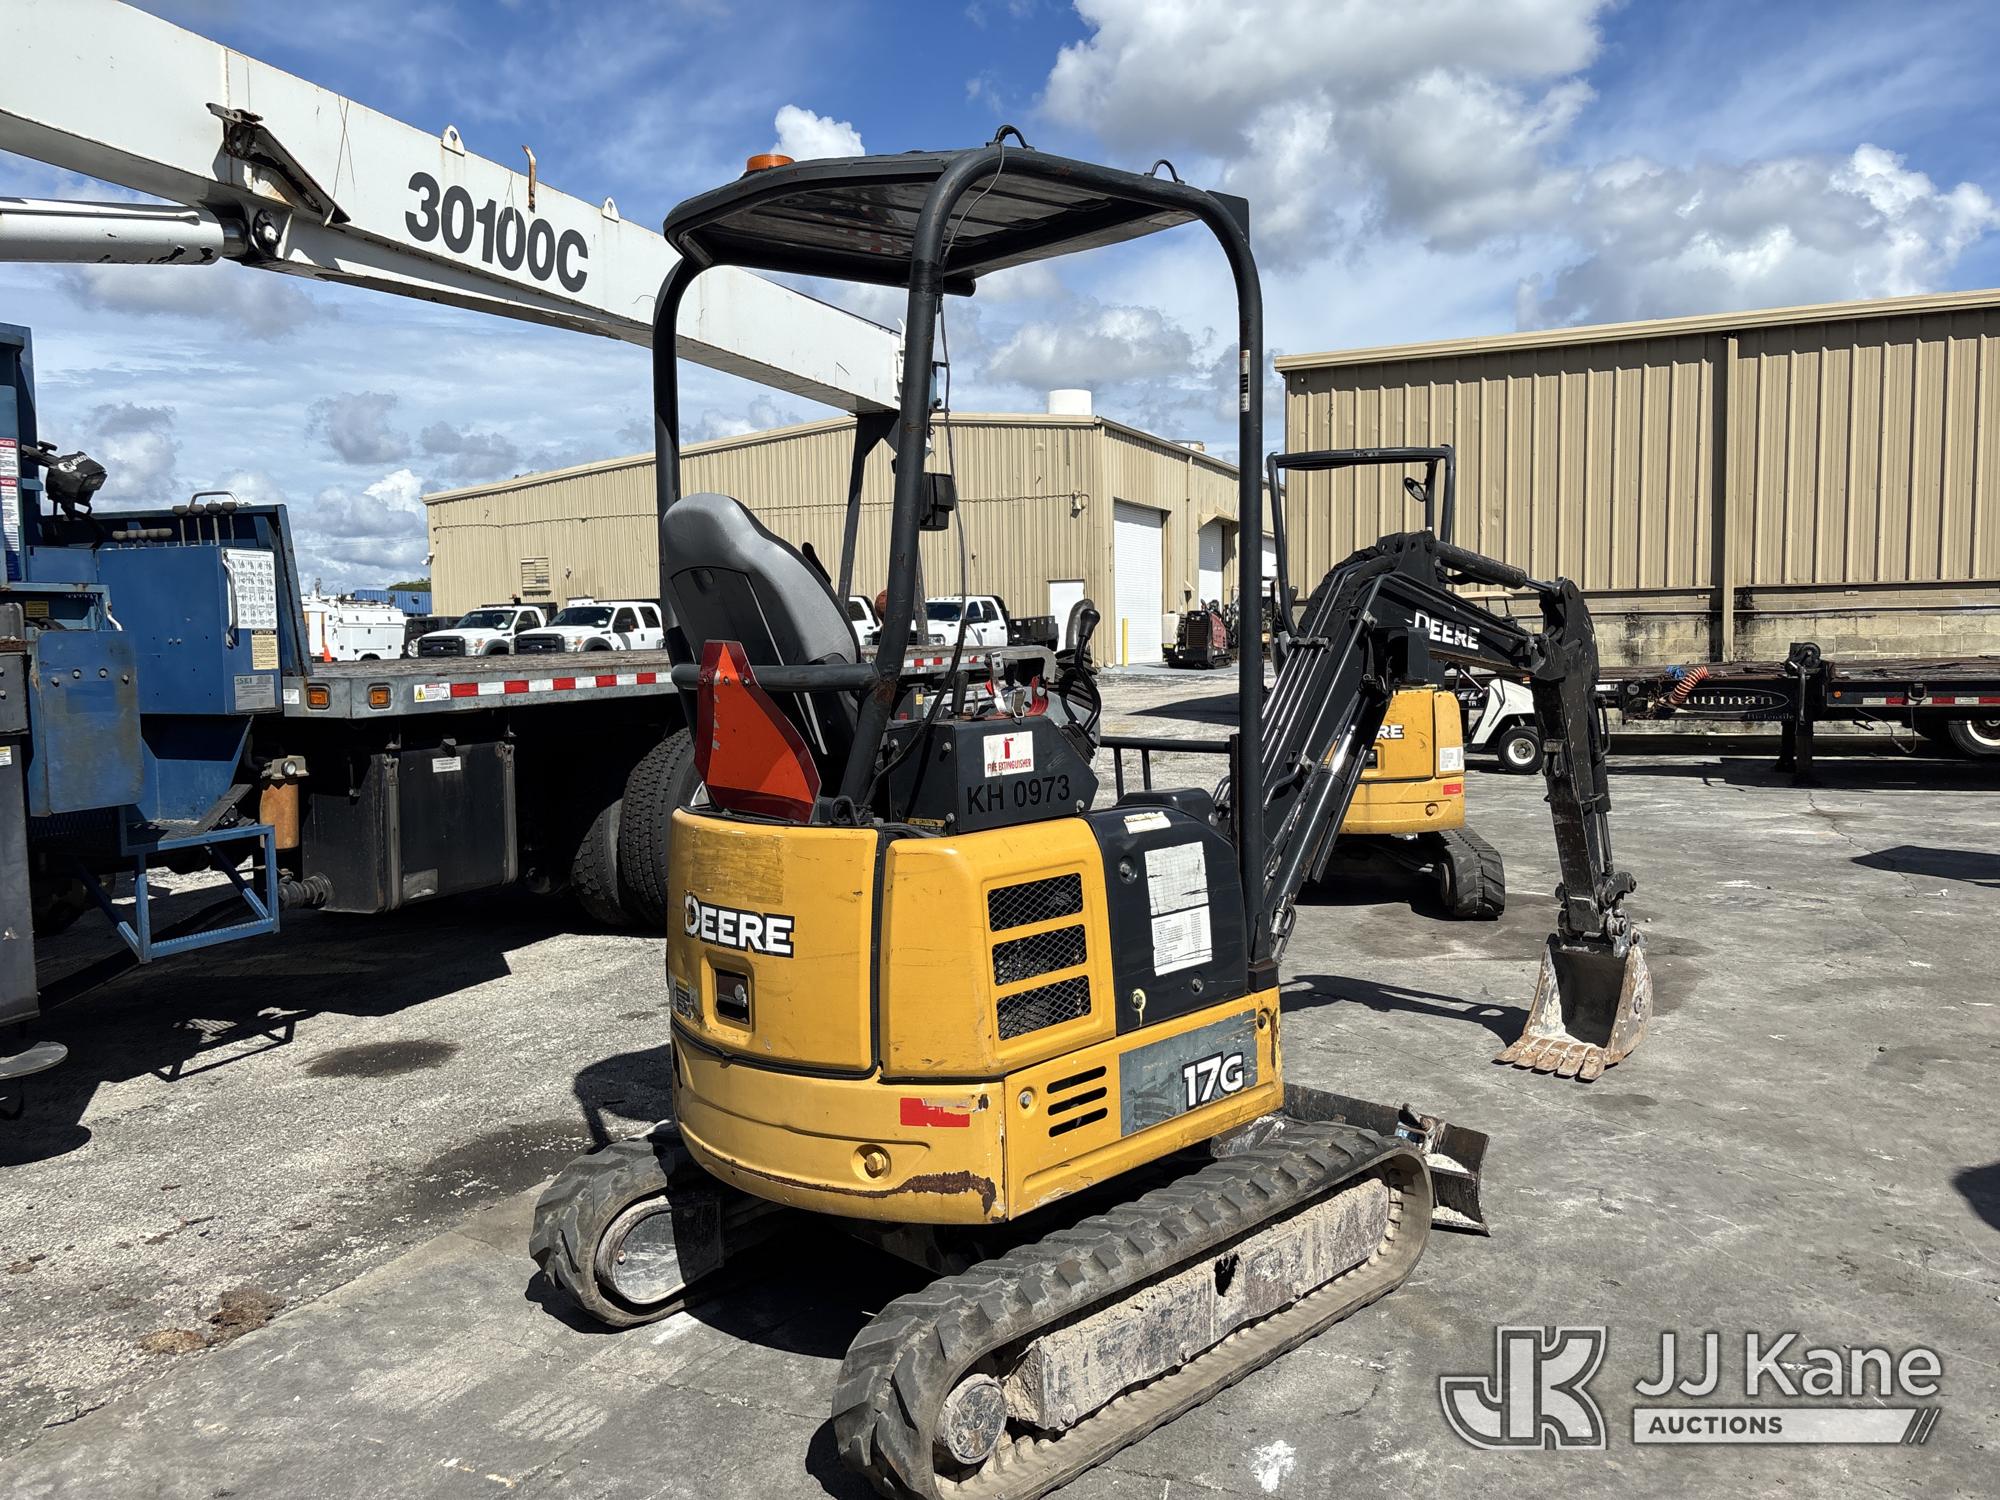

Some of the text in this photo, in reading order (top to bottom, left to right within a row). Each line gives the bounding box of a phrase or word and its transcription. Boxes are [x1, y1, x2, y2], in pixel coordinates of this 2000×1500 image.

[405, 171, 589, 293] 30100C
[1413, 608, 1480, 651] DEERE
[987, 758, 1032, 773] FIRE EXTINGUISHER
[967, 774, 1070, 815] KH 0973
[683, 892, 795, 957] DEERE
[1181, 1050, 1245, 1111] 17G
